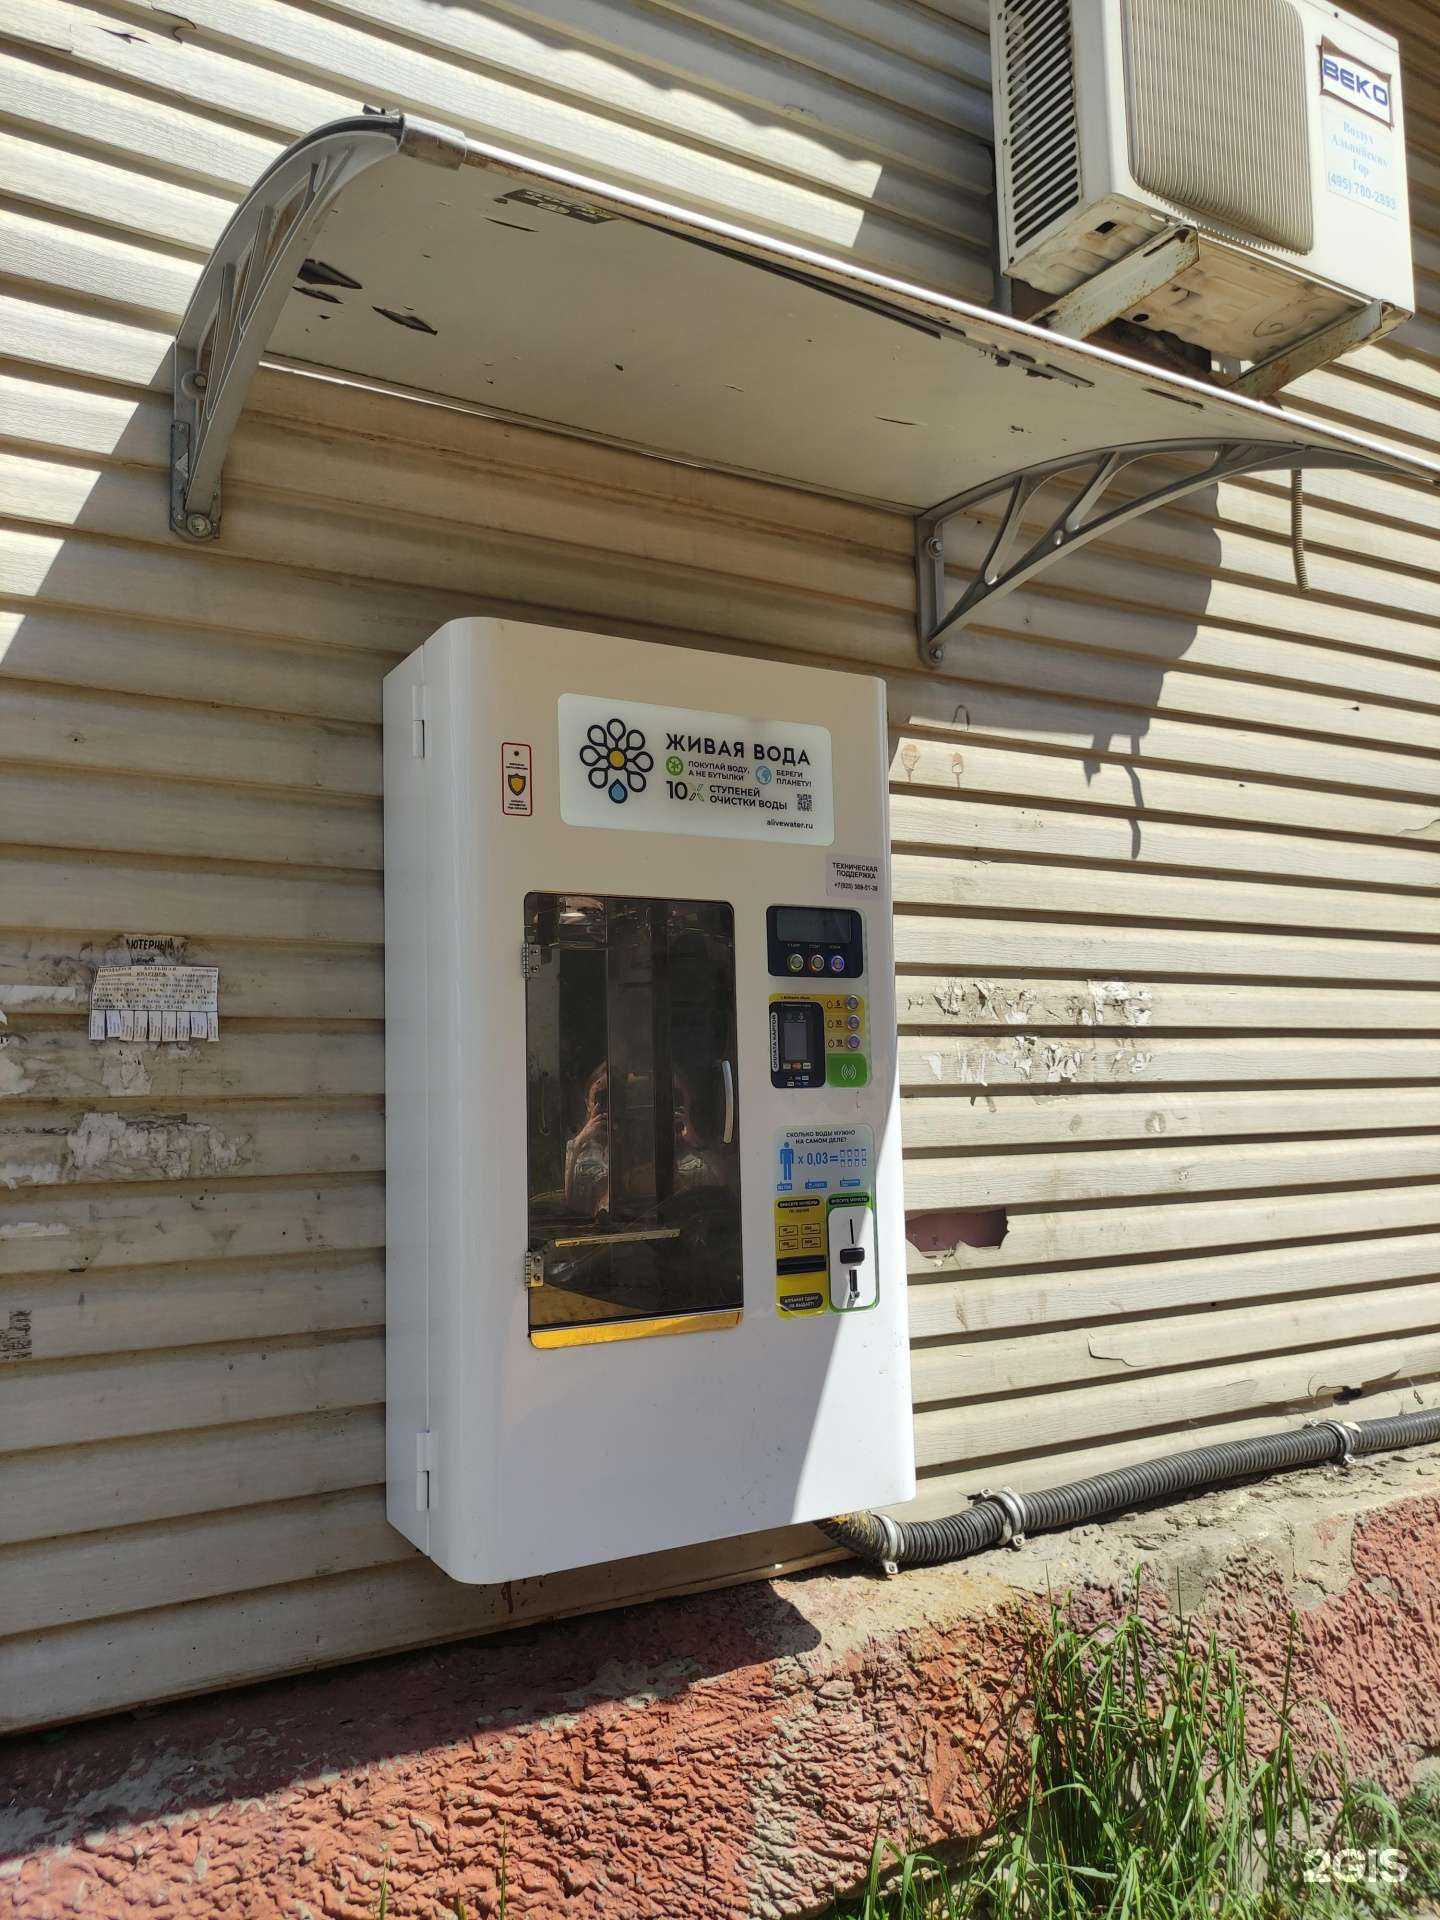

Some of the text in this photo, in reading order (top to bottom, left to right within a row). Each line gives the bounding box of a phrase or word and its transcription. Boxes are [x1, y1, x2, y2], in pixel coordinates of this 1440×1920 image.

[1322, 58, 1388, 106] BEKO
[665, 733, 810, 766] ЖИВАЯ ВОДА
[688, 760, 726, 772] ПОКУПАЙ
[688, 769, 744, 781] А НЕ БУТЫЛКИ
[776, 769, 803, 778] БЕРЕГИ
[776, 778, 812, 788] ПЛАНЕТУ!
[666, 780, 688, 800] 10
[709, 784, 761, 798] СТУПЕНЕЙ
[710, 795, 788, 811] ОЧИСТКИ ВОДЫ
[766, 818, 814, 830] alivewater.ru
[832, 862, 878, 873] ТЕХНИЧЕСКАЯ
[836, 869, 876, 879] ПОДДЕРЖКА
